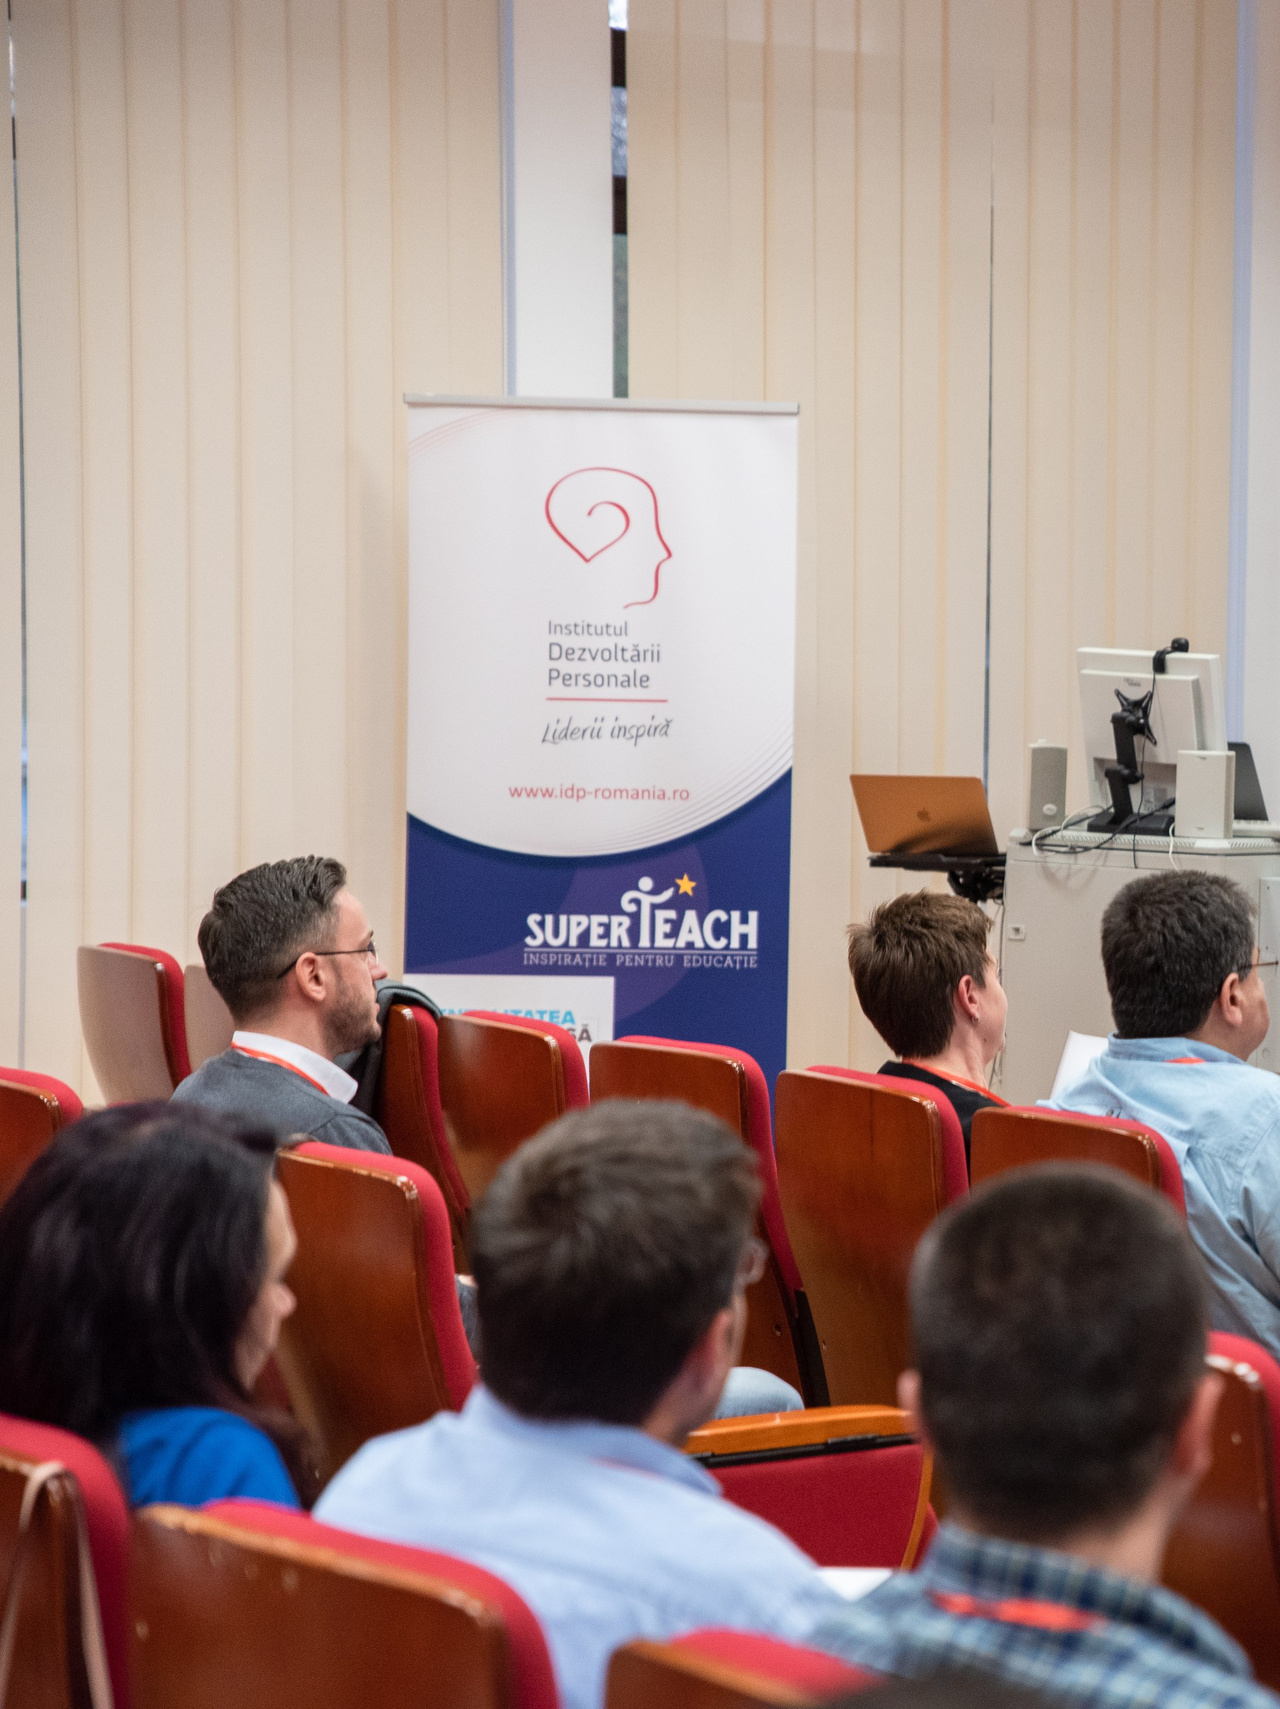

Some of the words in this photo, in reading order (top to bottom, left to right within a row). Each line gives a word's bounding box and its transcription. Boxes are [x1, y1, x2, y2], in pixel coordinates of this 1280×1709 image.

[547, 620, 629, 637] Institutul
[548, 642, 661, 663] Dezvoltării
[547, 668, 650, 689] Personale
[541, 716, 606, 744] Liderii
[610, 715, 673, 747] inspiră
[508, 784, 691, 803] www.idp-romania.ro
[615, 954, 675, 967] PENTRU
[682, 955, 758, 970] EDUCAȚIE
